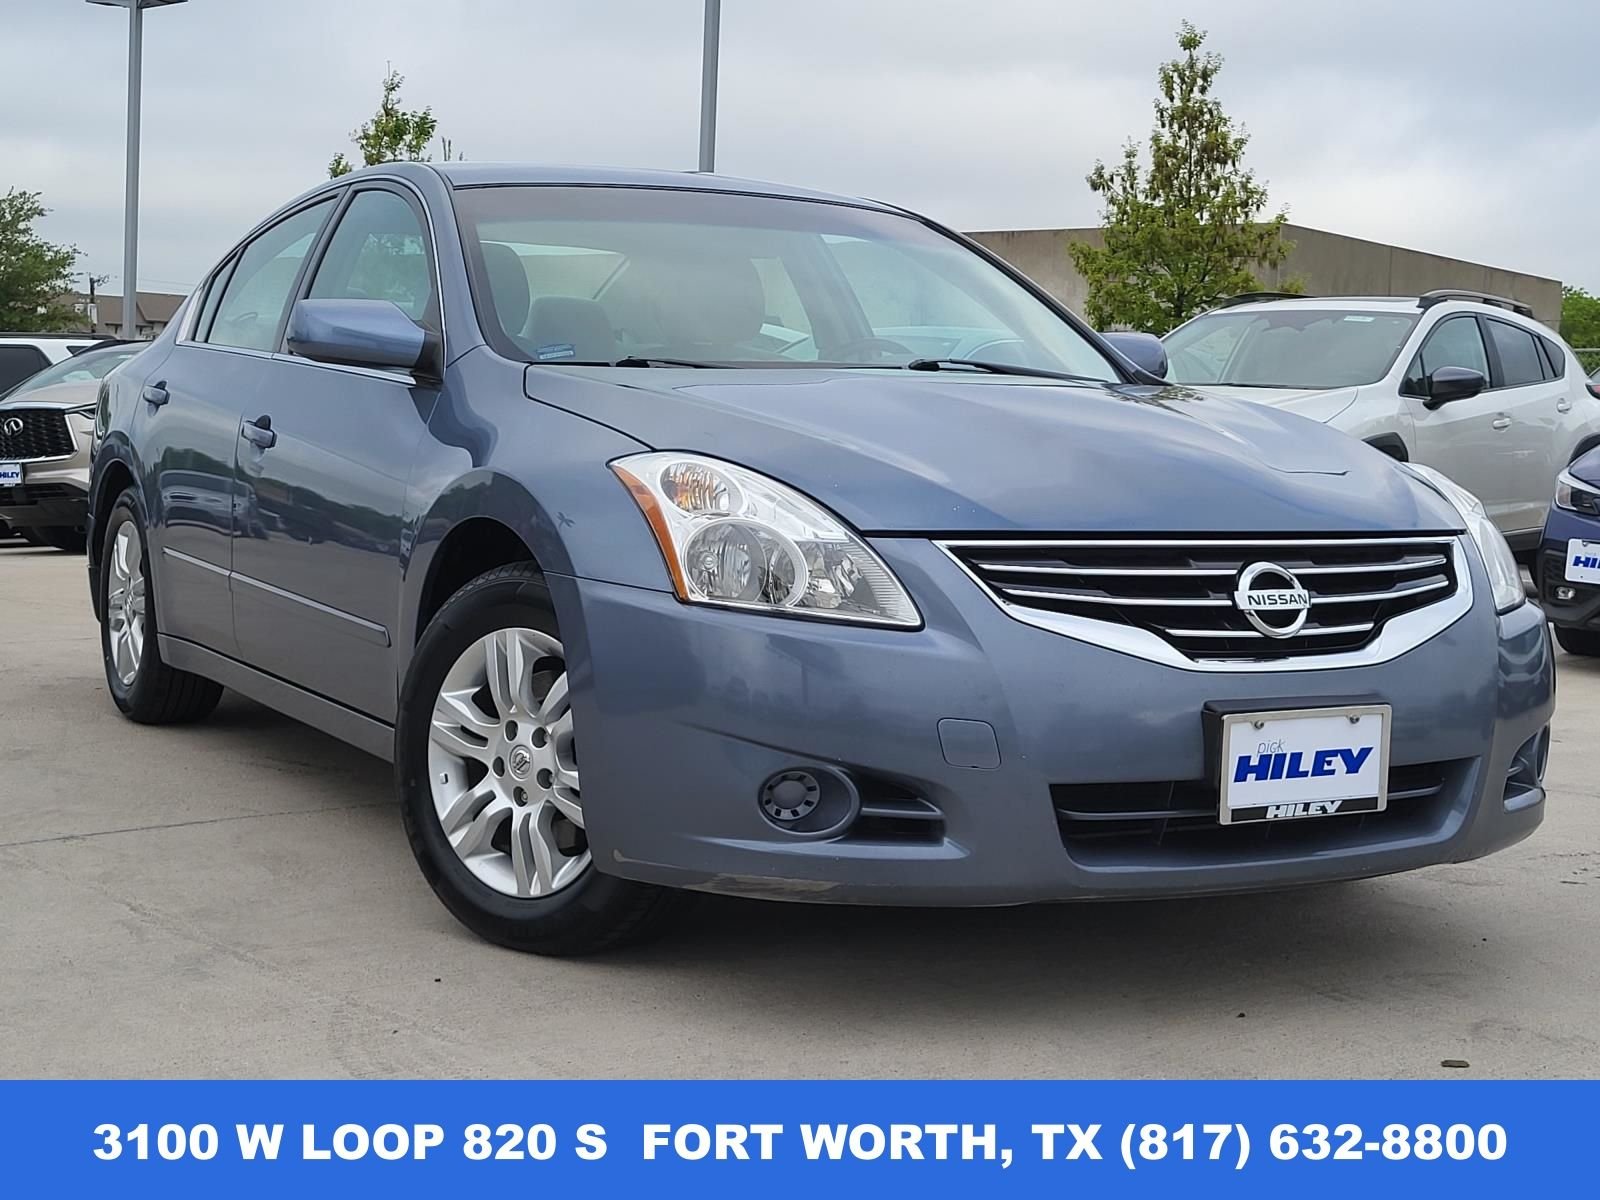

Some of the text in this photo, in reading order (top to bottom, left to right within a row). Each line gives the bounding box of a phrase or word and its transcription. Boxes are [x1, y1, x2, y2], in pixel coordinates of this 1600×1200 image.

[1247, 593, 1308, 606] NISSAN
[1256, 739, 1285, 757] pick
[1233, 747, 1374, 783] HILEY
[1266, 801, 1343, 819] HILEY
